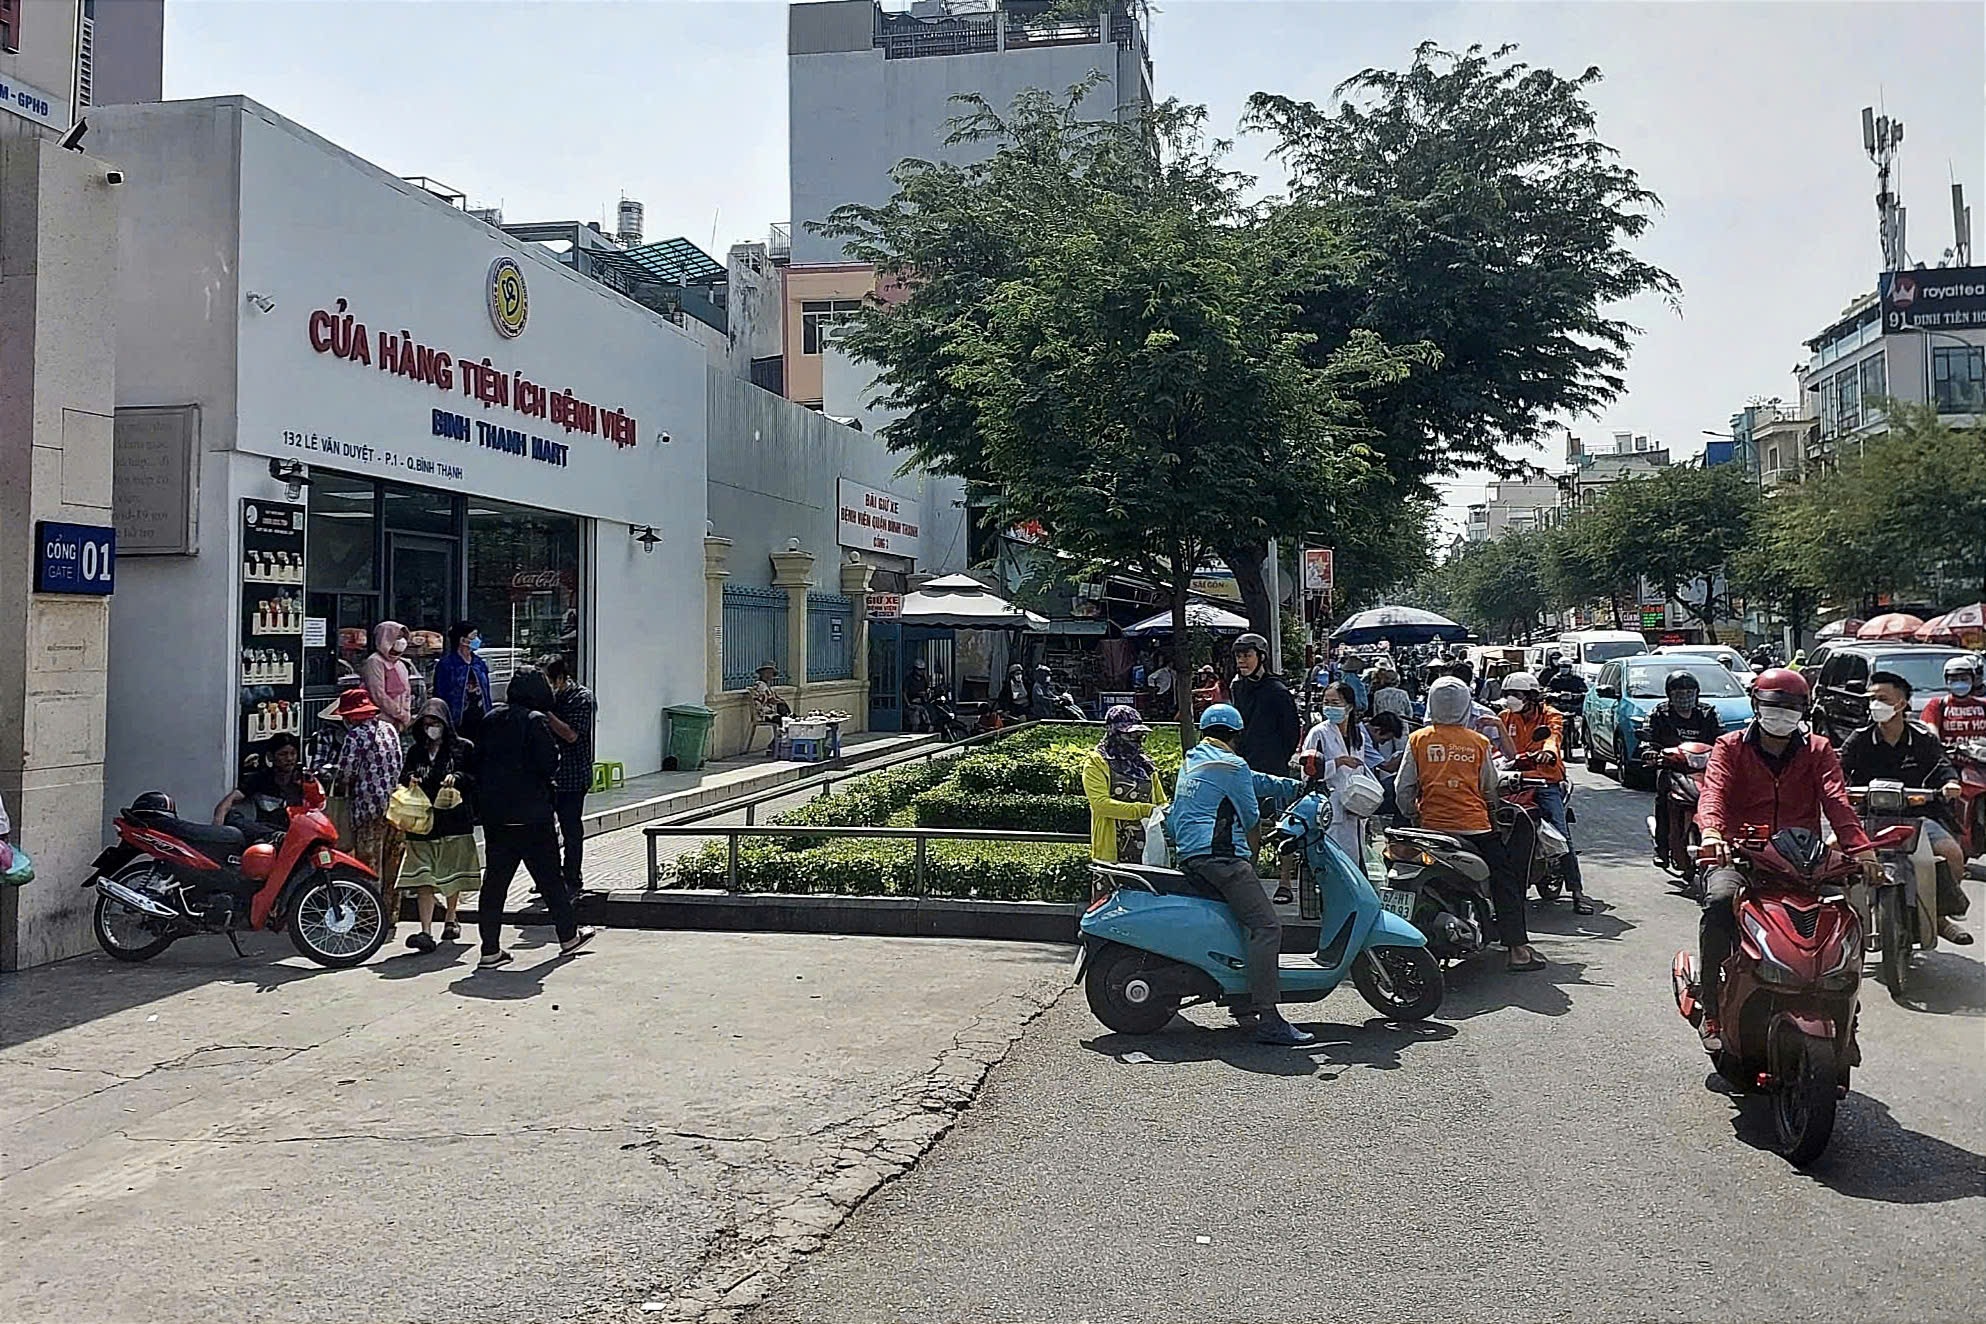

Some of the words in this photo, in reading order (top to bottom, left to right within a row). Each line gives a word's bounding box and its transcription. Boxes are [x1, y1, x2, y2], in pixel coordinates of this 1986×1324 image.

[1889, 310, 1907, 328] 91
[308, 297, 371, 366] CỬA
[379, 329, 453, 389] HÀNG
[458, 357, 509, 409] TIỆN
[513, 370, 546, 419] ÍCH
[550, 387, 597, 434] BỆNH
[600, 407, 636, 449] VIỆN
[283, 430, 302, 448] 132
[304, 433, 318, 451] LÊ
[321, 436, 340, 456] VĂN
[343, 443, 375, 464] DUYỆT
[385, 452, 398, 467] P.1
[437, 463, 463, 481] THẠNH
[531, 436, 569, 467] MART
[890, 500, 899, 515] XE
[46, 533, 77, 560] CỔNG
[48, 565, 73, 579] GATE
[82, 541, 111, 581] 01
[885, 596, 899, 605] XE
[1448, 752, 1475, 763] Food
